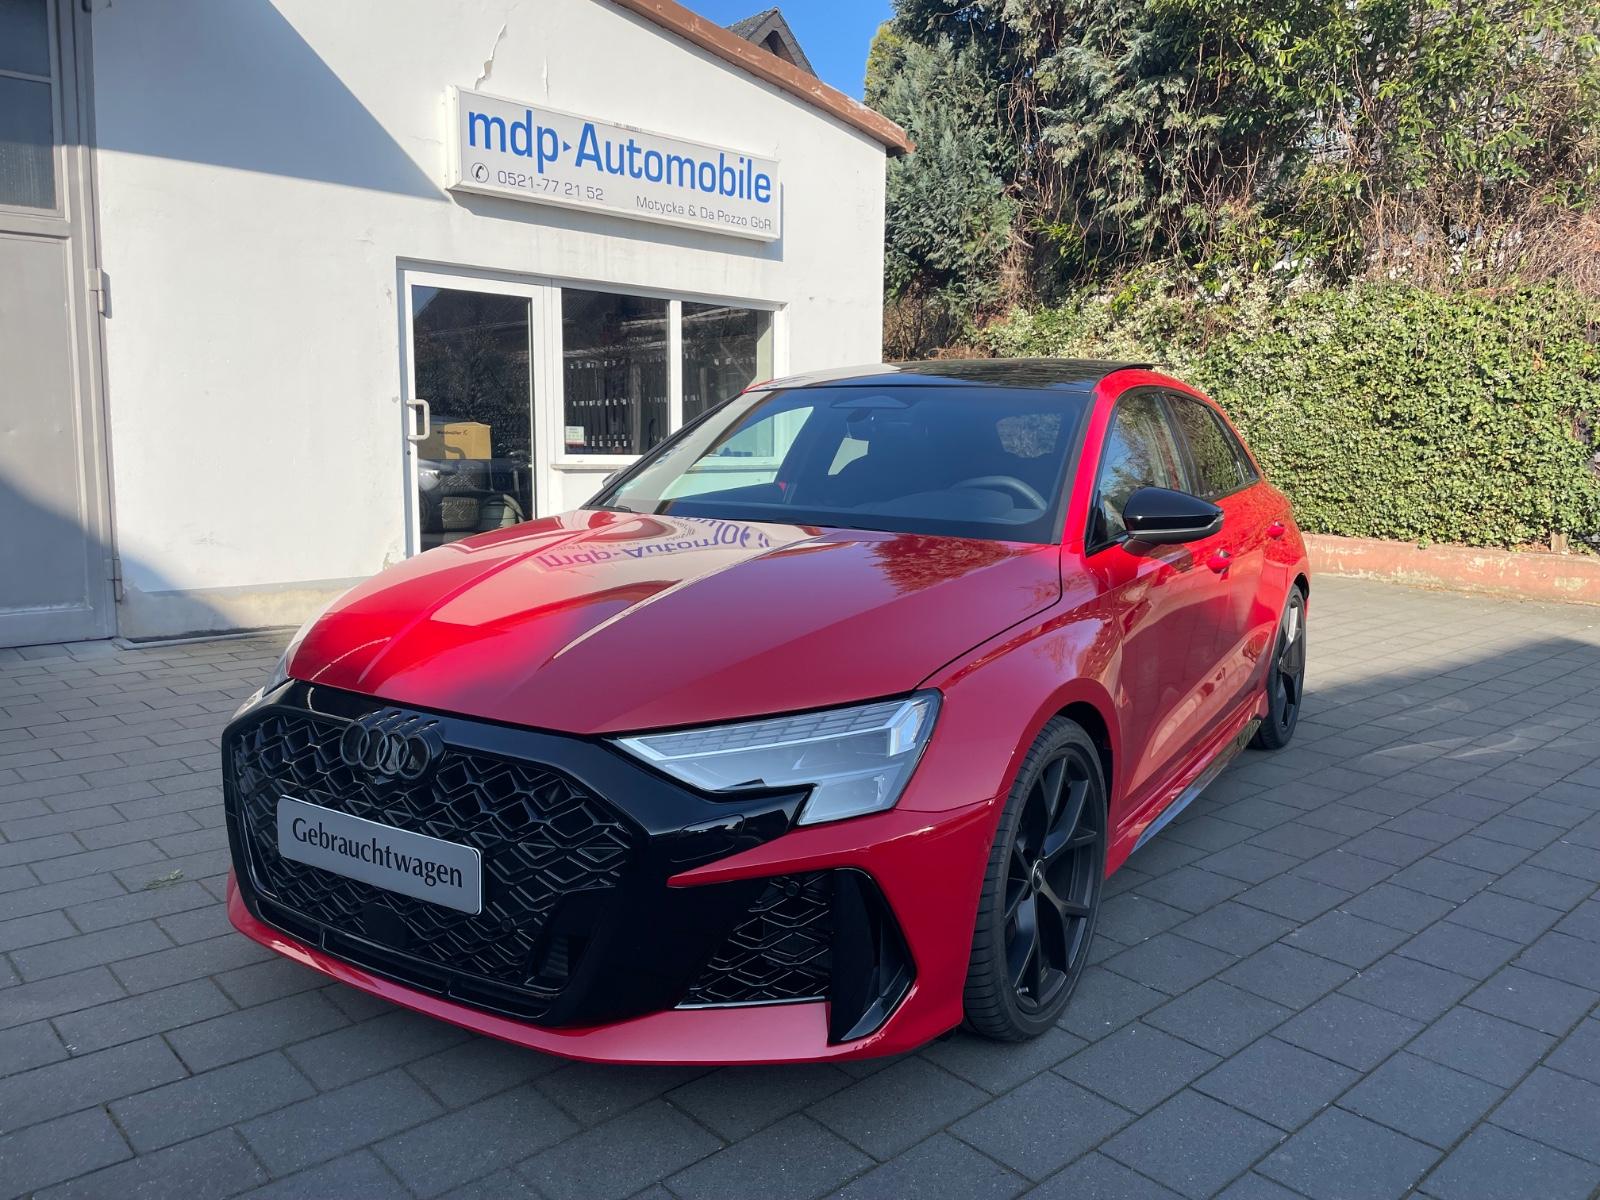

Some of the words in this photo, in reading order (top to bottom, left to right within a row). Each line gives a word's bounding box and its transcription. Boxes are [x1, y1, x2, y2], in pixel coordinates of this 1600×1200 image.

[468, 109, 559, 174] mdp
[575, 122, 771, 203] Automobile
[497, 170, 559, 193] 0521-77
[564, 182, 580, 197] 21
[586, 186, 604, 201] 52
[636, 195, 685, 215] Motycka
[688, 204, 697, 217] &
[700, 206, 715, 220] Da
[717, 209, 748, 226] Pozzo
[750, 216, 772, 230] GbR
[292, 817, 463, 889] Gebrauchtwagen
